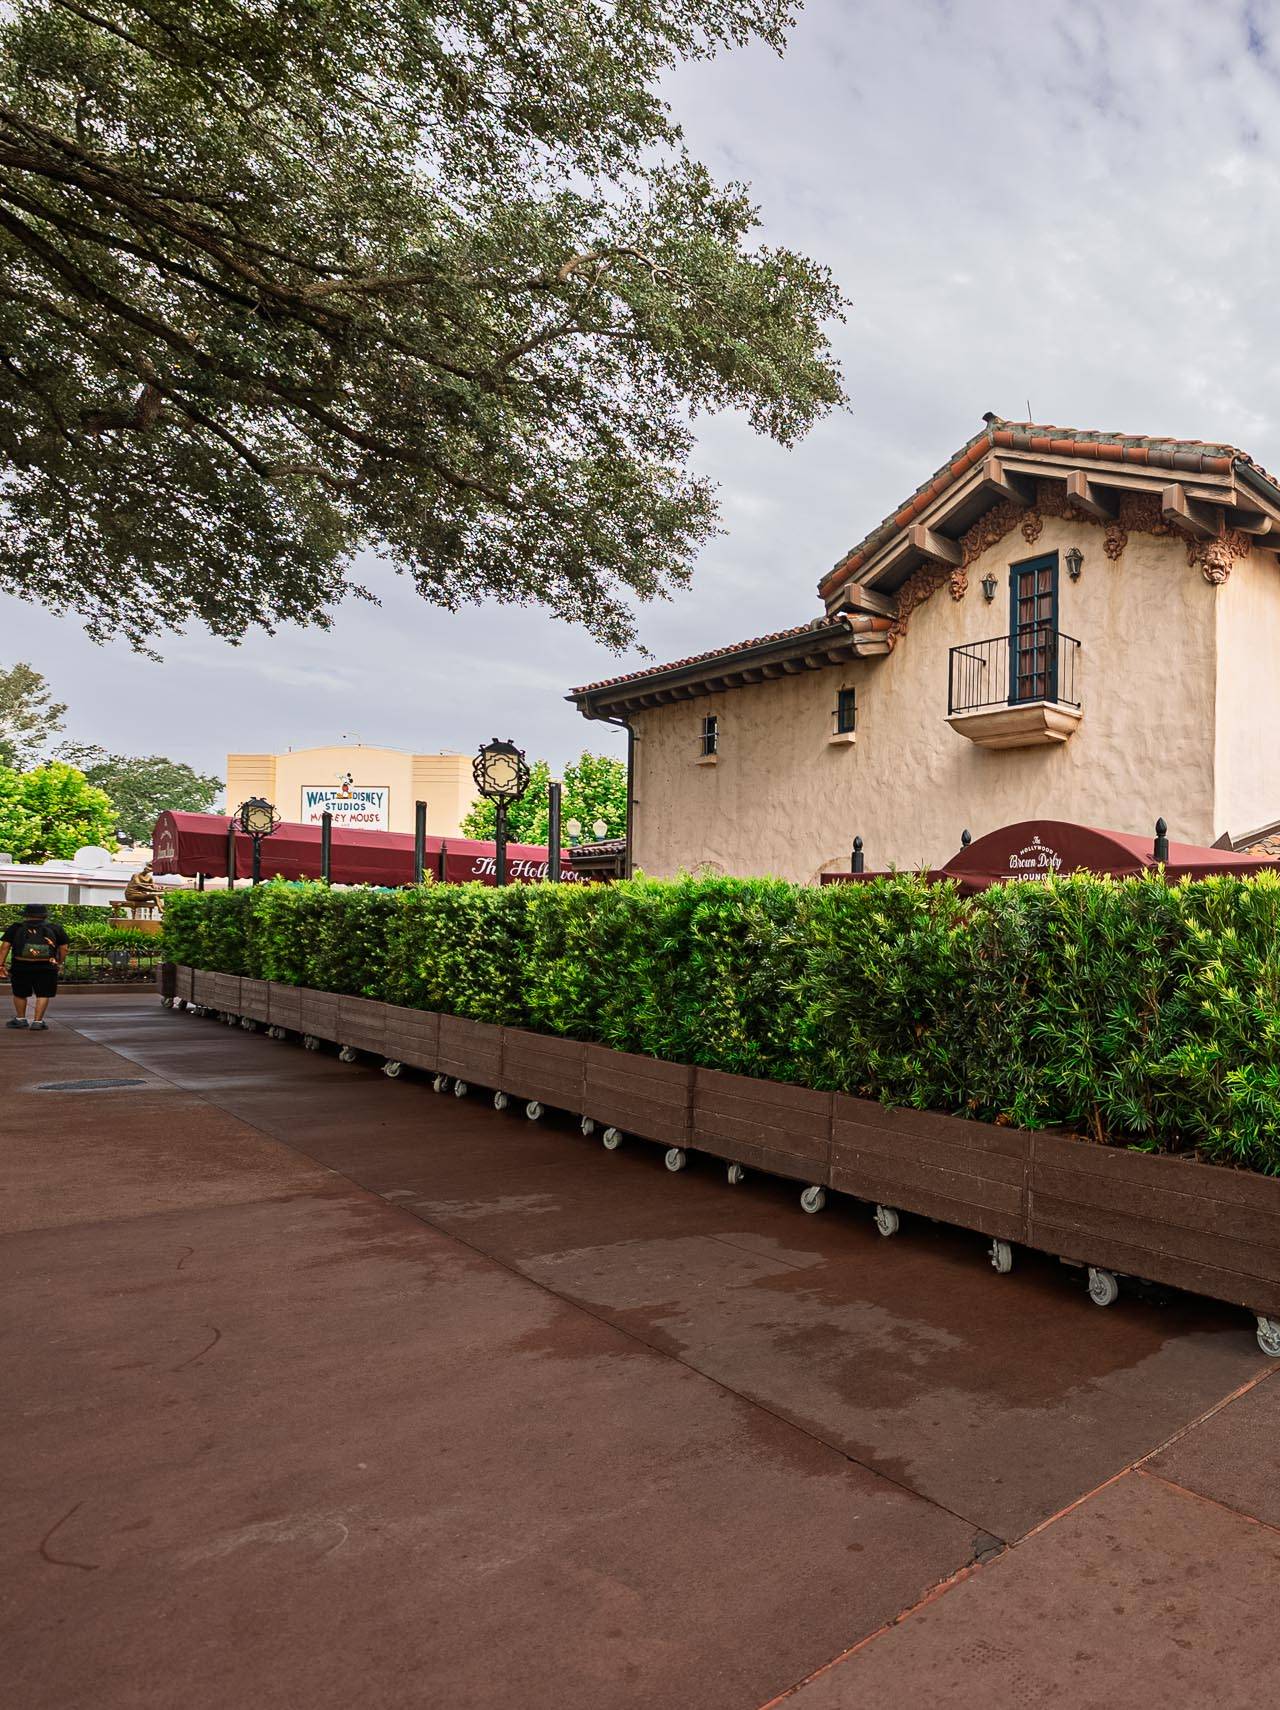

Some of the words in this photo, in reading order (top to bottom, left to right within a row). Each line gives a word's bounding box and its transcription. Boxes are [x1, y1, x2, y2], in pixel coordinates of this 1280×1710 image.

[306, 791, 337, 808] WALT
[352, 791, 384, 809] DISNEY
[325, 802, 366, 811] STUDIOS
[349, 813, 381, 823] MOUSE
[1020, 845, 1054, 856] HOLLYWOOD
[1009, 854, 1036, 869] Brown
[1037, 852, 1063, 871] Derby
[1018, 873, 1049, 881] LOUNG
